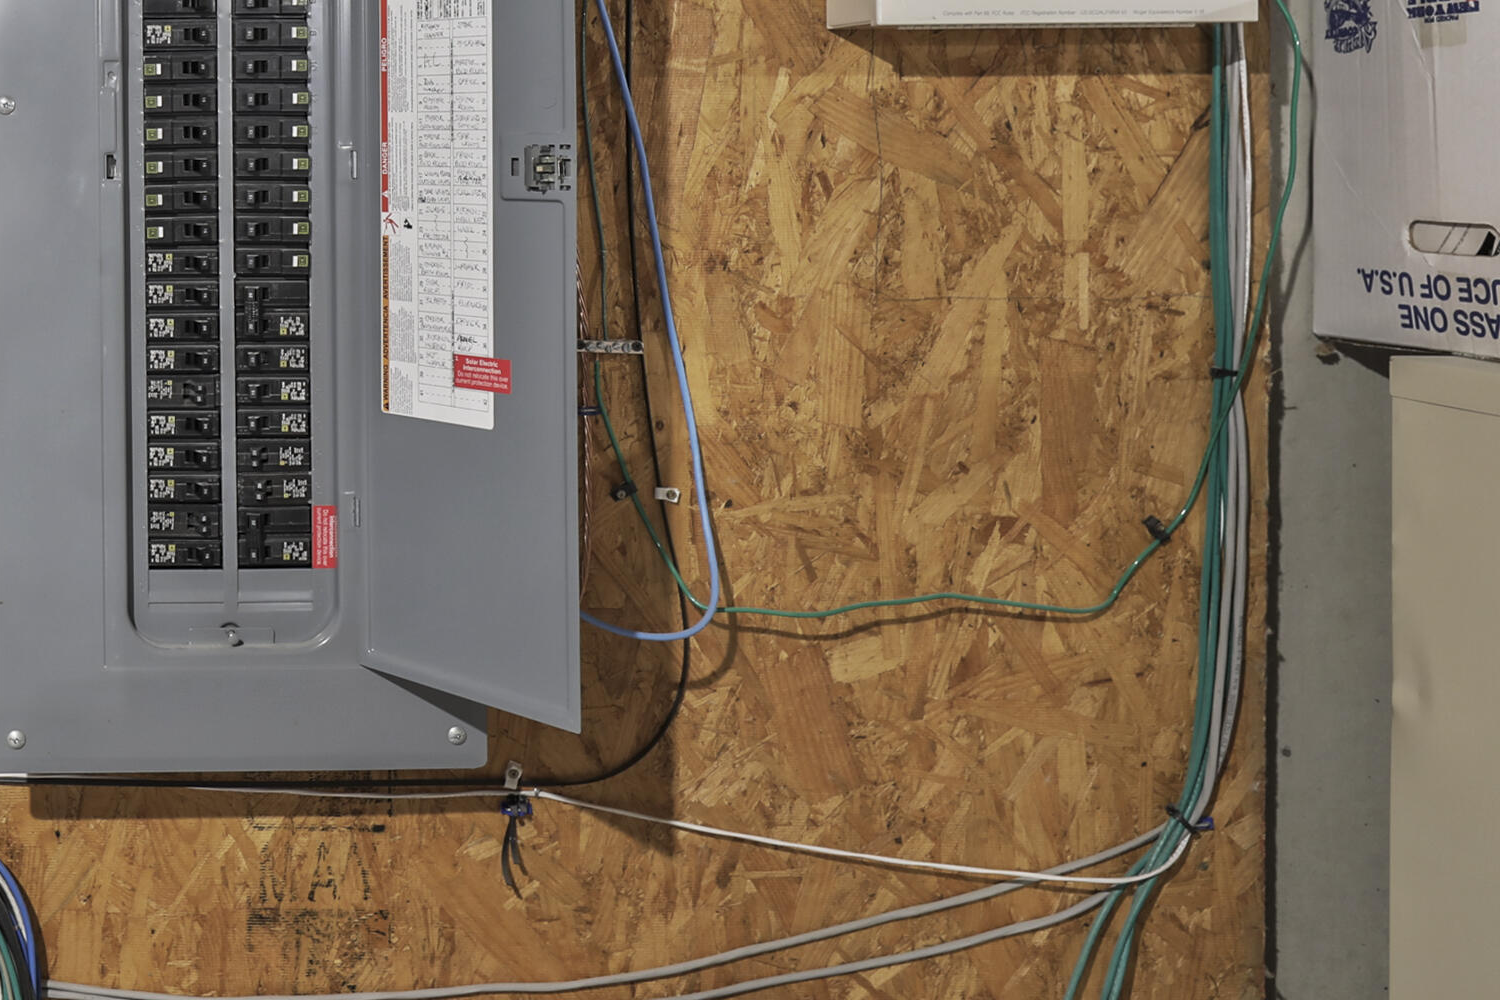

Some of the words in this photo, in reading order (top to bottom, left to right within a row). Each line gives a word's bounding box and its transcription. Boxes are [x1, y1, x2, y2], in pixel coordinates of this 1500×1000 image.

[1406, 3, 1447, 19] YORK
[381, 141, 389, 175] DANGER
[1356, 268, 1415, 298] U.S.A.
[1420, 274, 1452, 301] OF
[1398, 303, 1448, 333] ONE
[462, 364, 502, 375] Interconnection
[479, 359, 499, 368] Electric
